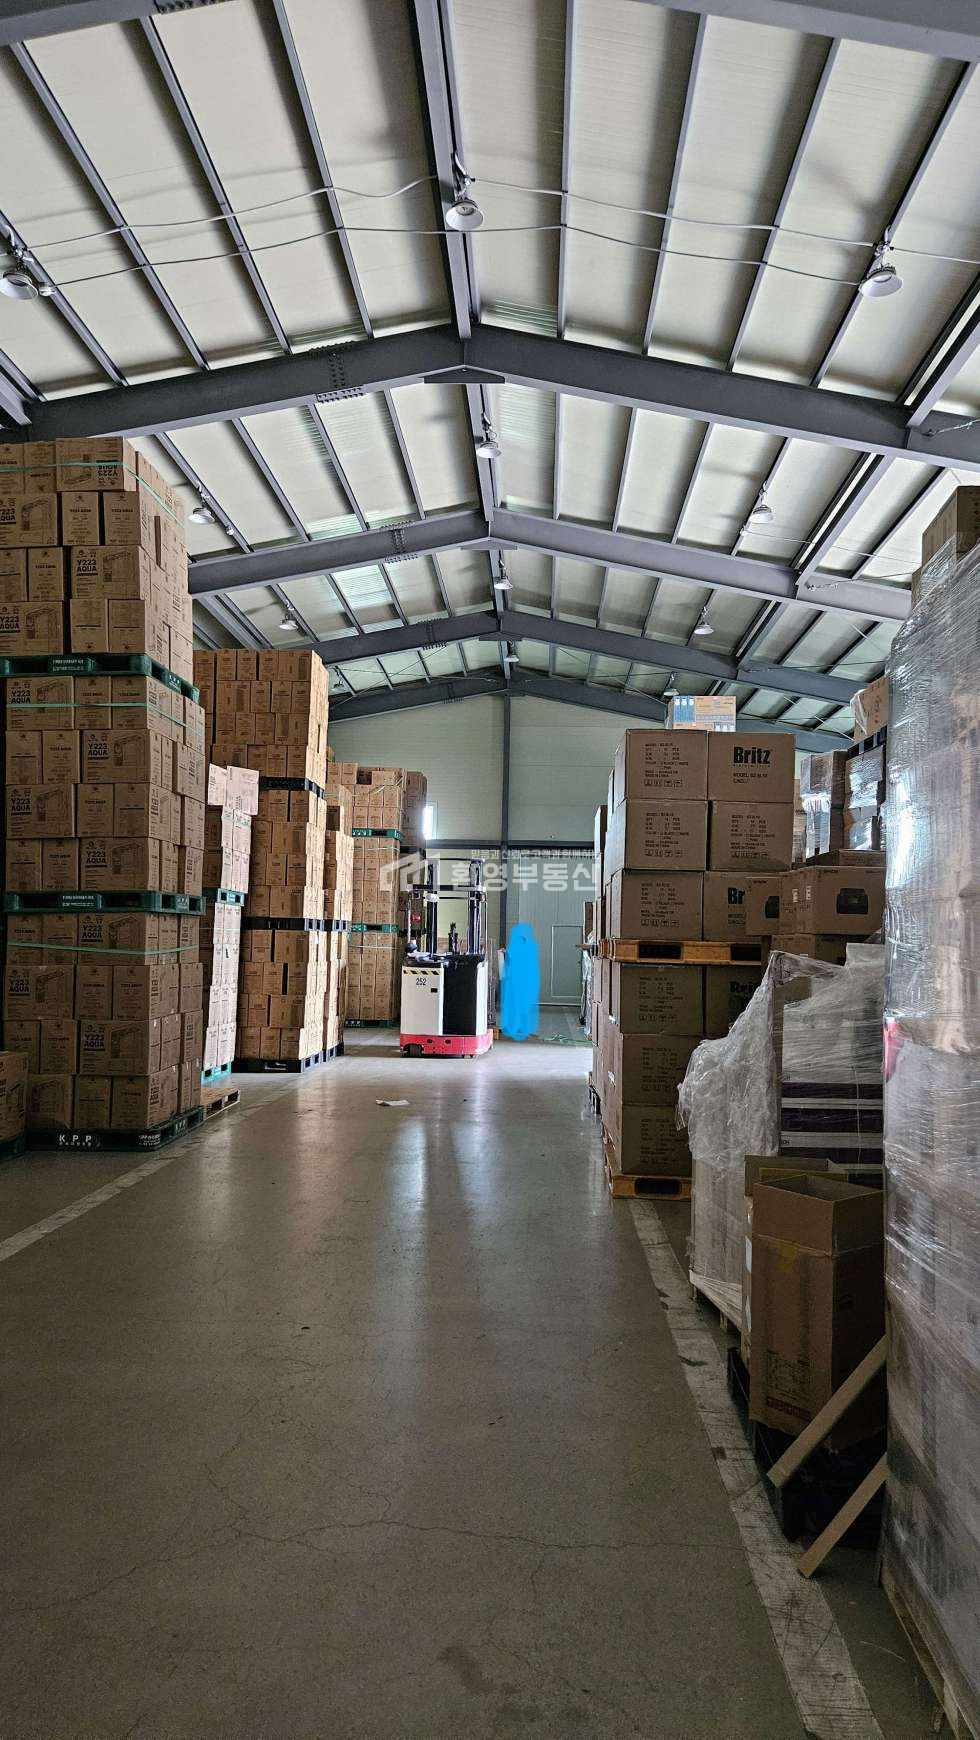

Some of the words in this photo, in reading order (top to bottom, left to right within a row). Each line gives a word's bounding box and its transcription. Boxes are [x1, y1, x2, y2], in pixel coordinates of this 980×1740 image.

[734, 747, 770, 765] Britz
[728, 887, 746, 904] Br
[415, 977, 427, 986] 252
